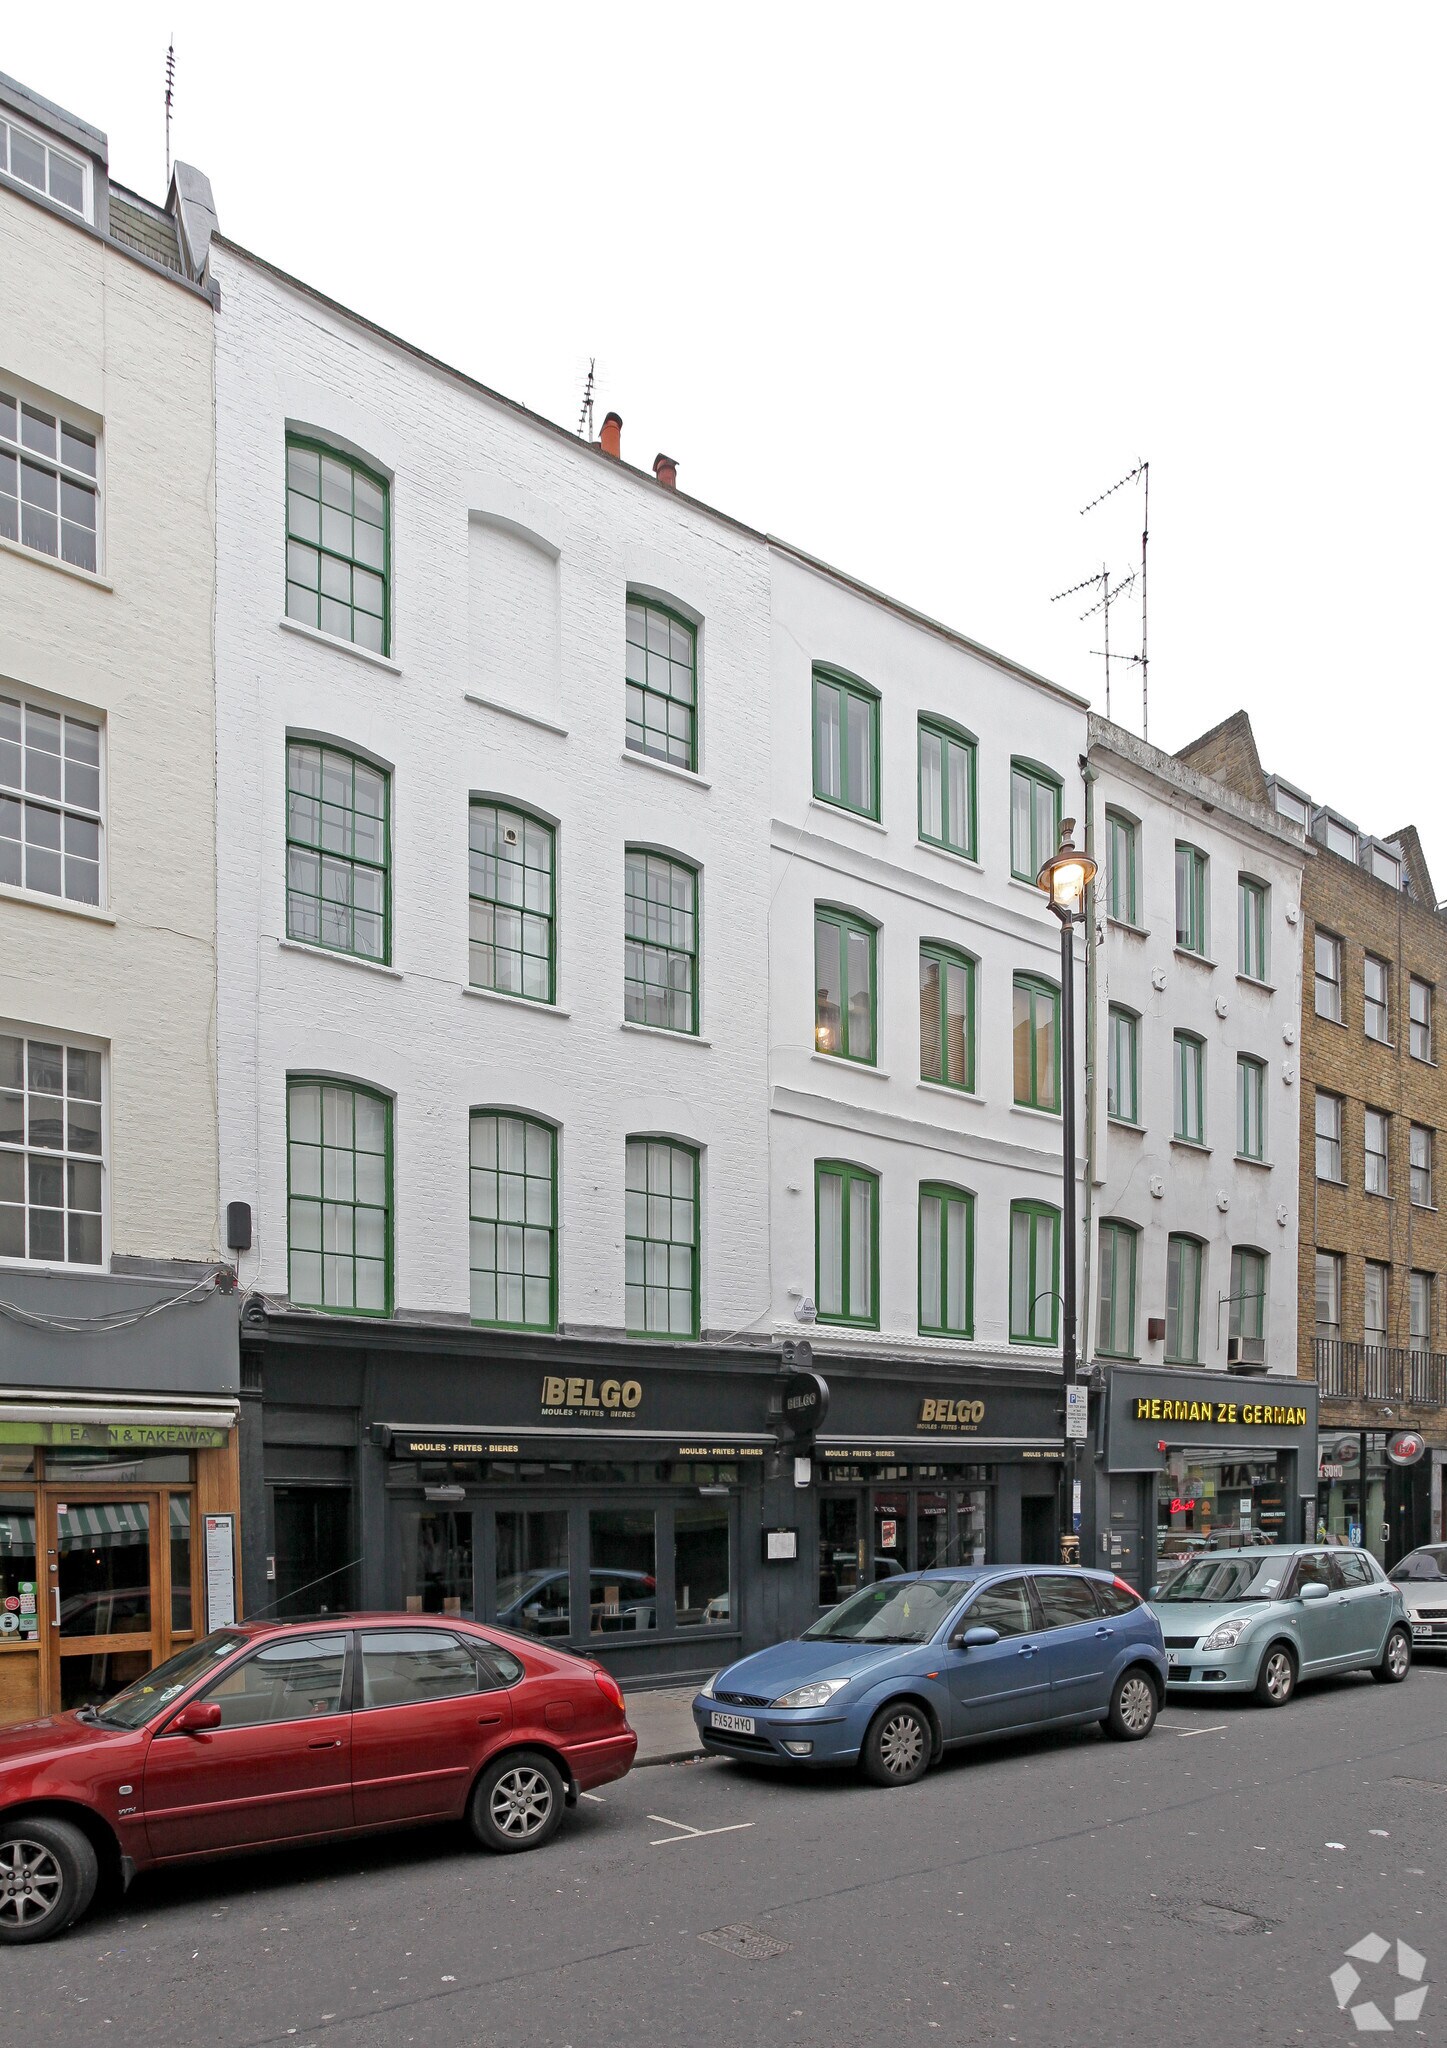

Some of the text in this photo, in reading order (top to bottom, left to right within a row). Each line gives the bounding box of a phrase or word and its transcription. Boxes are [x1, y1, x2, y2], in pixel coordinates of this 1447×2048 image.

[541, 1376, 642, 1408] BELGO
[787, 1393, 817, 1409] BELGO
[541, 1408, 636, 1418] MOULES FRITES BIERES
[921, 1398, 985, 1423] BELGO
[1137, 1398, 1307, 1425] HERMAN ZE GERMAN
[123, 1429, 134, 1441] &
[138, 1430, 215, 1443] TAKEAWAY
[410, 1443, 447, 1451] MOULES
[453, 1444, 482, 1452] FRITES
[1324, 1464, 1343, 1477] SOHO
[1351, 1528, 1361, 1543] £8
[714, 1713, 751, 1732] FX52 HYO
